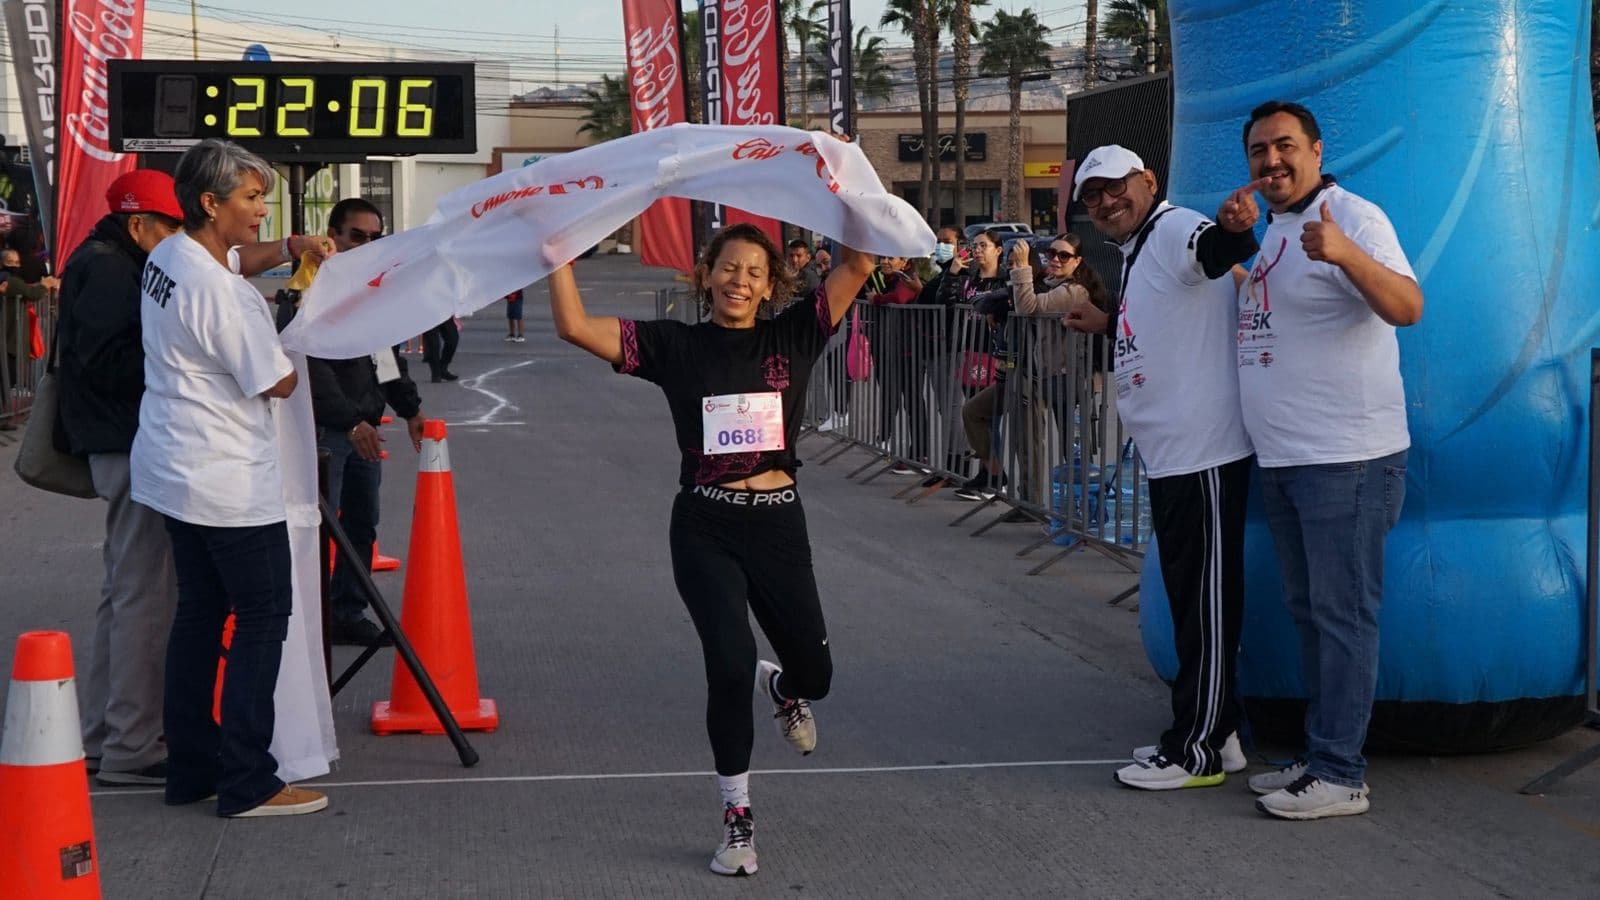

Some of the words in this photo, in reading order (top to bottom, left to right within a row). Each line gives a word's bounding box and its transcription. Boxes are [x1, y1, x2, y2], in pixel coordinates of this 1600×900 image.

[142, 260, 177, 309] STAFF
[1251, 312, 1272, 330] 5K
[1118, 335, 1138, 357] 5K
[693, 485, 750, 505] NIKE
[752, 489, 795, 506] PRO
